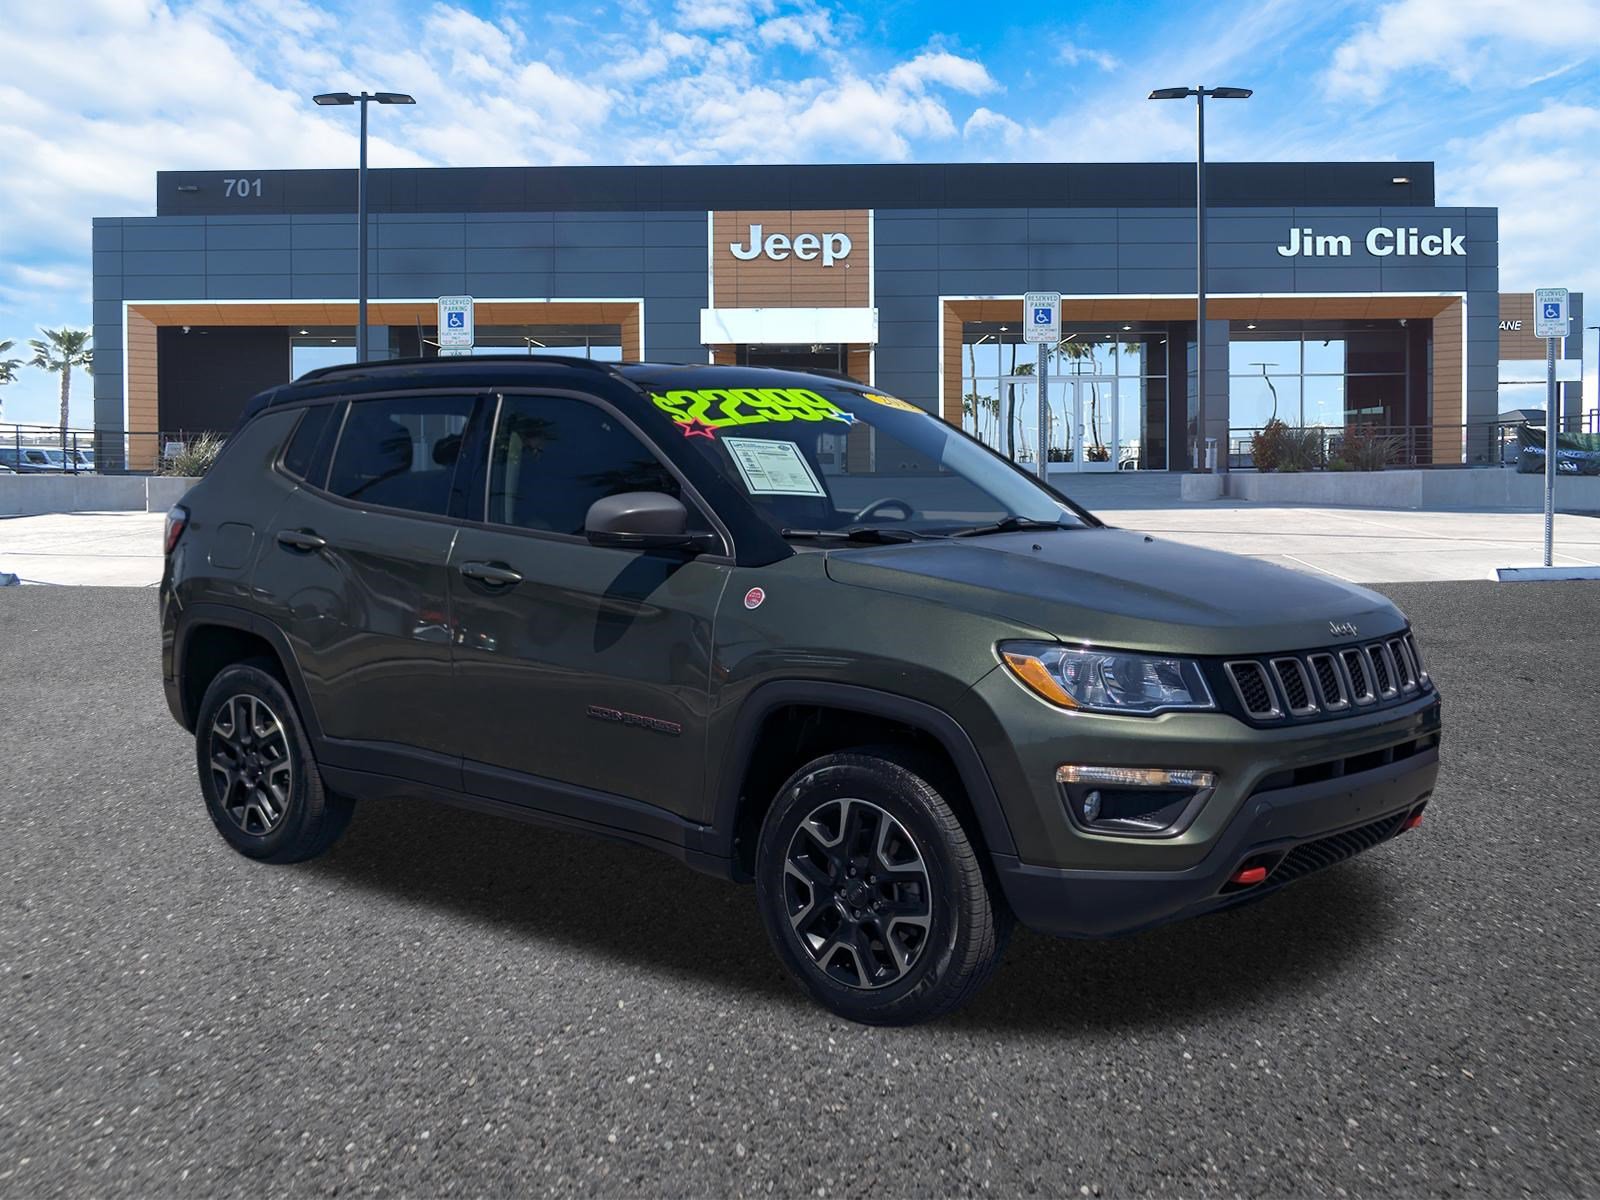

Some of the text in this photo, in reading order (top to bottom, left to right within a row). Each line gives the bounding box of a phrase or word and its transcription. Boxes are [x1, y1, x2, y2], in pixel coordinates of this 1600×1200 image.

[223, 178, 262, 197] 701
[730, 224, 852, 267] Jeep
[1277, 227, 1467, 257] Jim Click
[650, 387, 850, 428] $22999
[1329, 621, 1358, 637] Jeep
